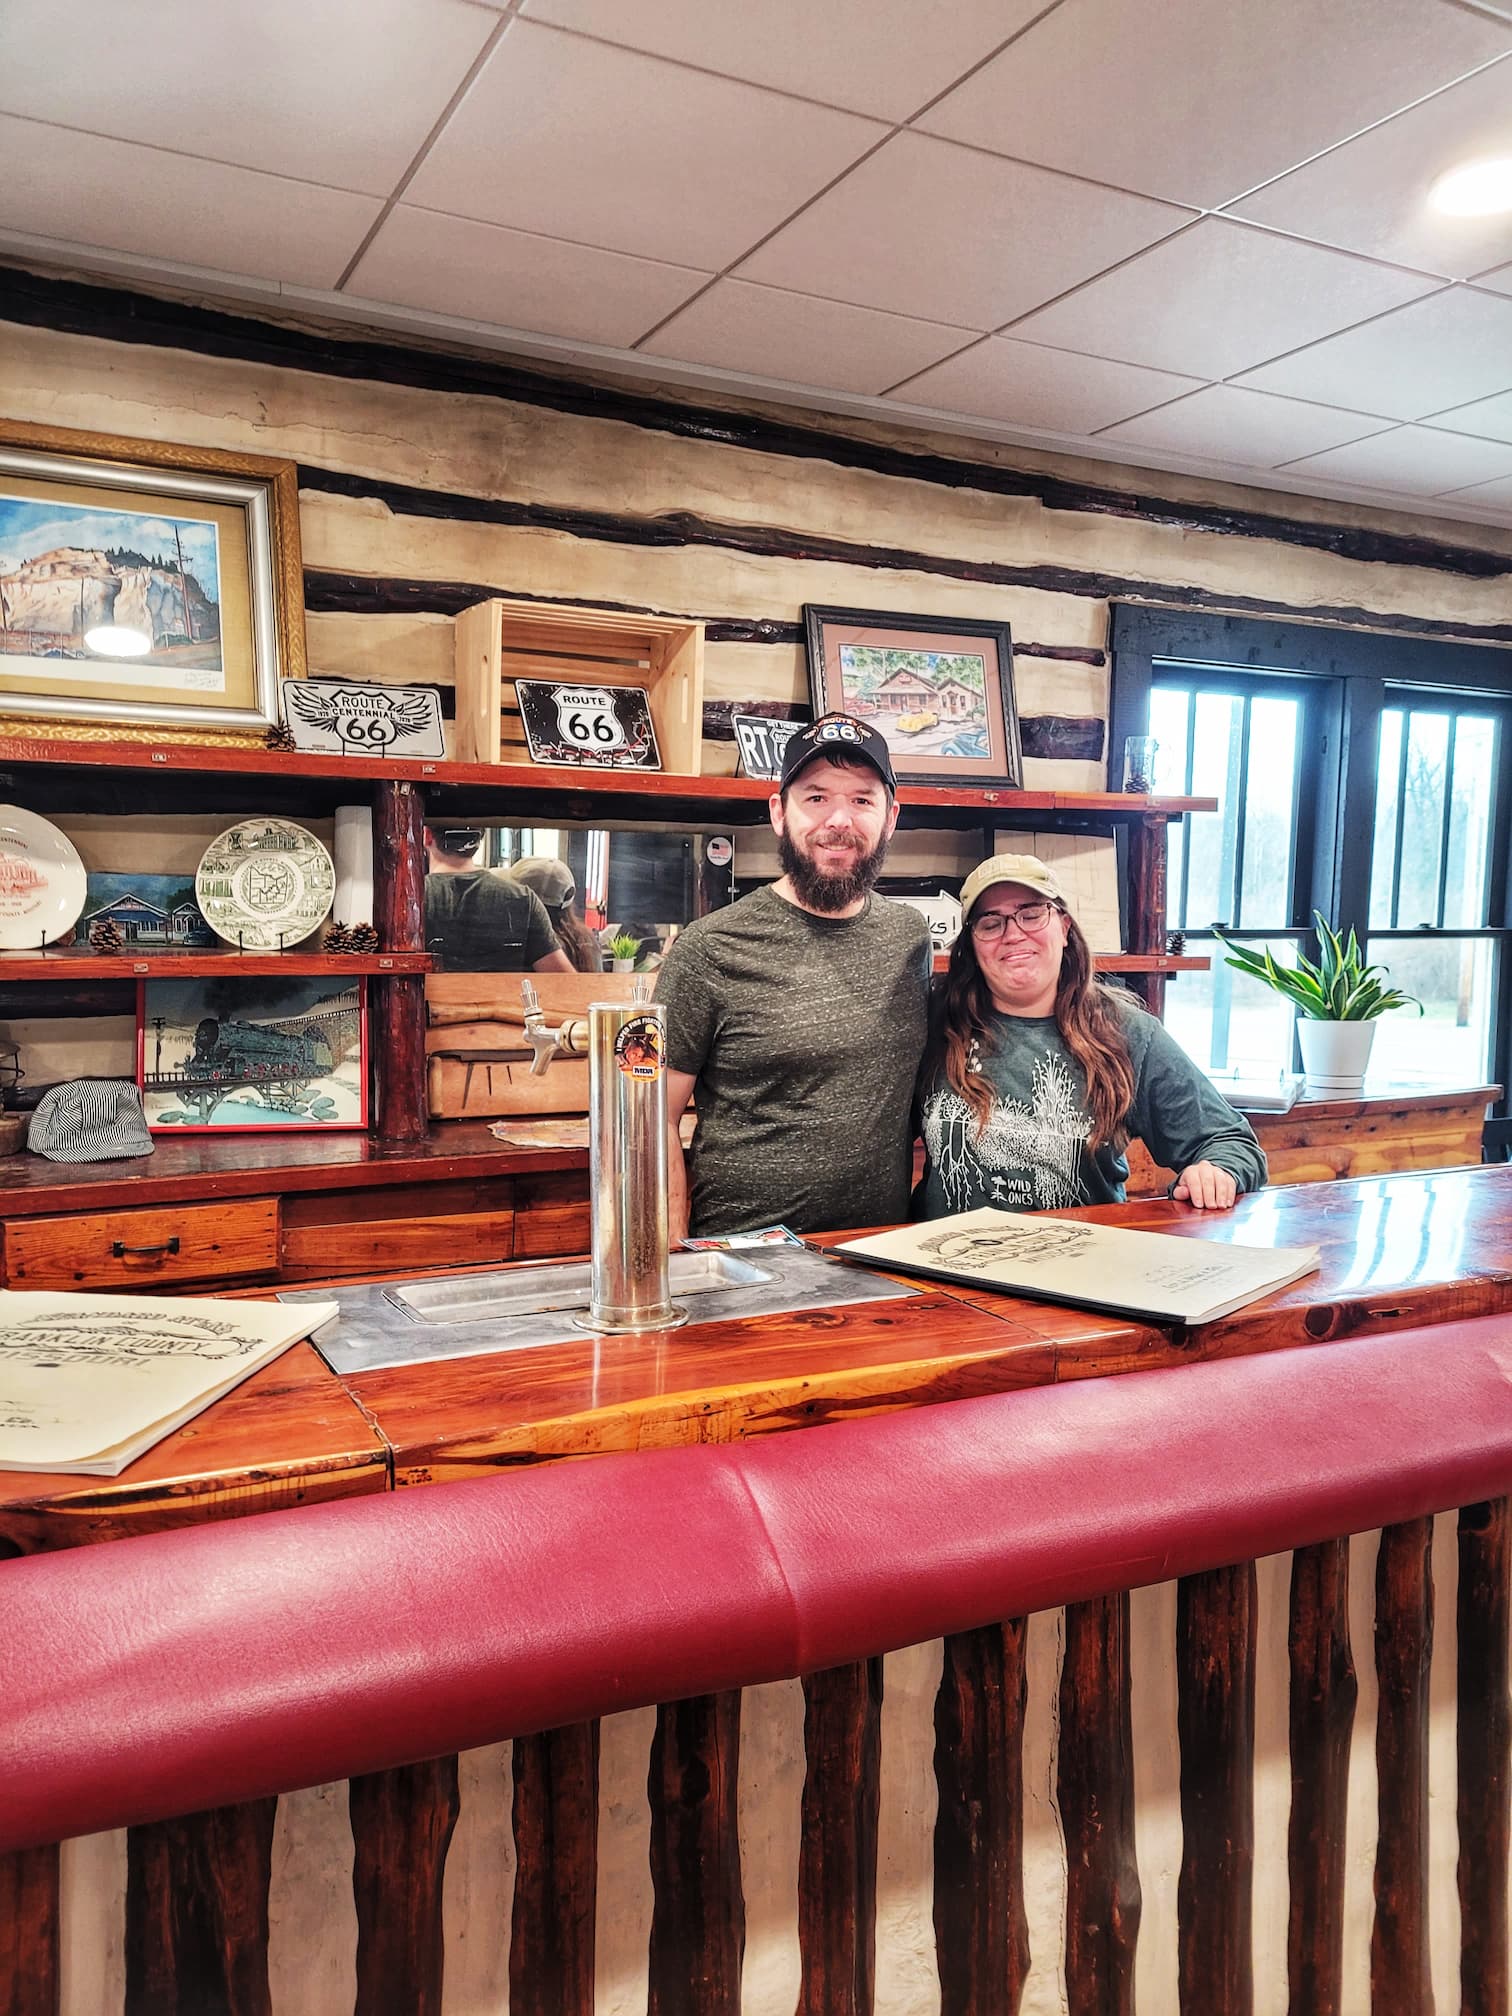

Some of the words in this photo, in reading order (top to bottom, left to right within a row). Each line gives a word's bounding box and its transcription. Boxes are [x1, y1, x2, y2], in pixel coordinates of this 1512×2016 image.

[342, 697, 383, 709] ROUTE
[563, 695, 607, 706] ROUTE
[332, 708, 395, 720] CENTENNIAL
[822, 717, 854, 725] ROUTE
[346, 718, 387, 742] 66
[569, 713, 614, 742] 66
[822, 724, 856, 740] 66
[738, 724, 772, 768] RT
[1007, 1178, 1032, 1192] WILD
[0, 1330, 112, 1346] RANKLIN
[113, 1336, 212, 1352] COUNTY
